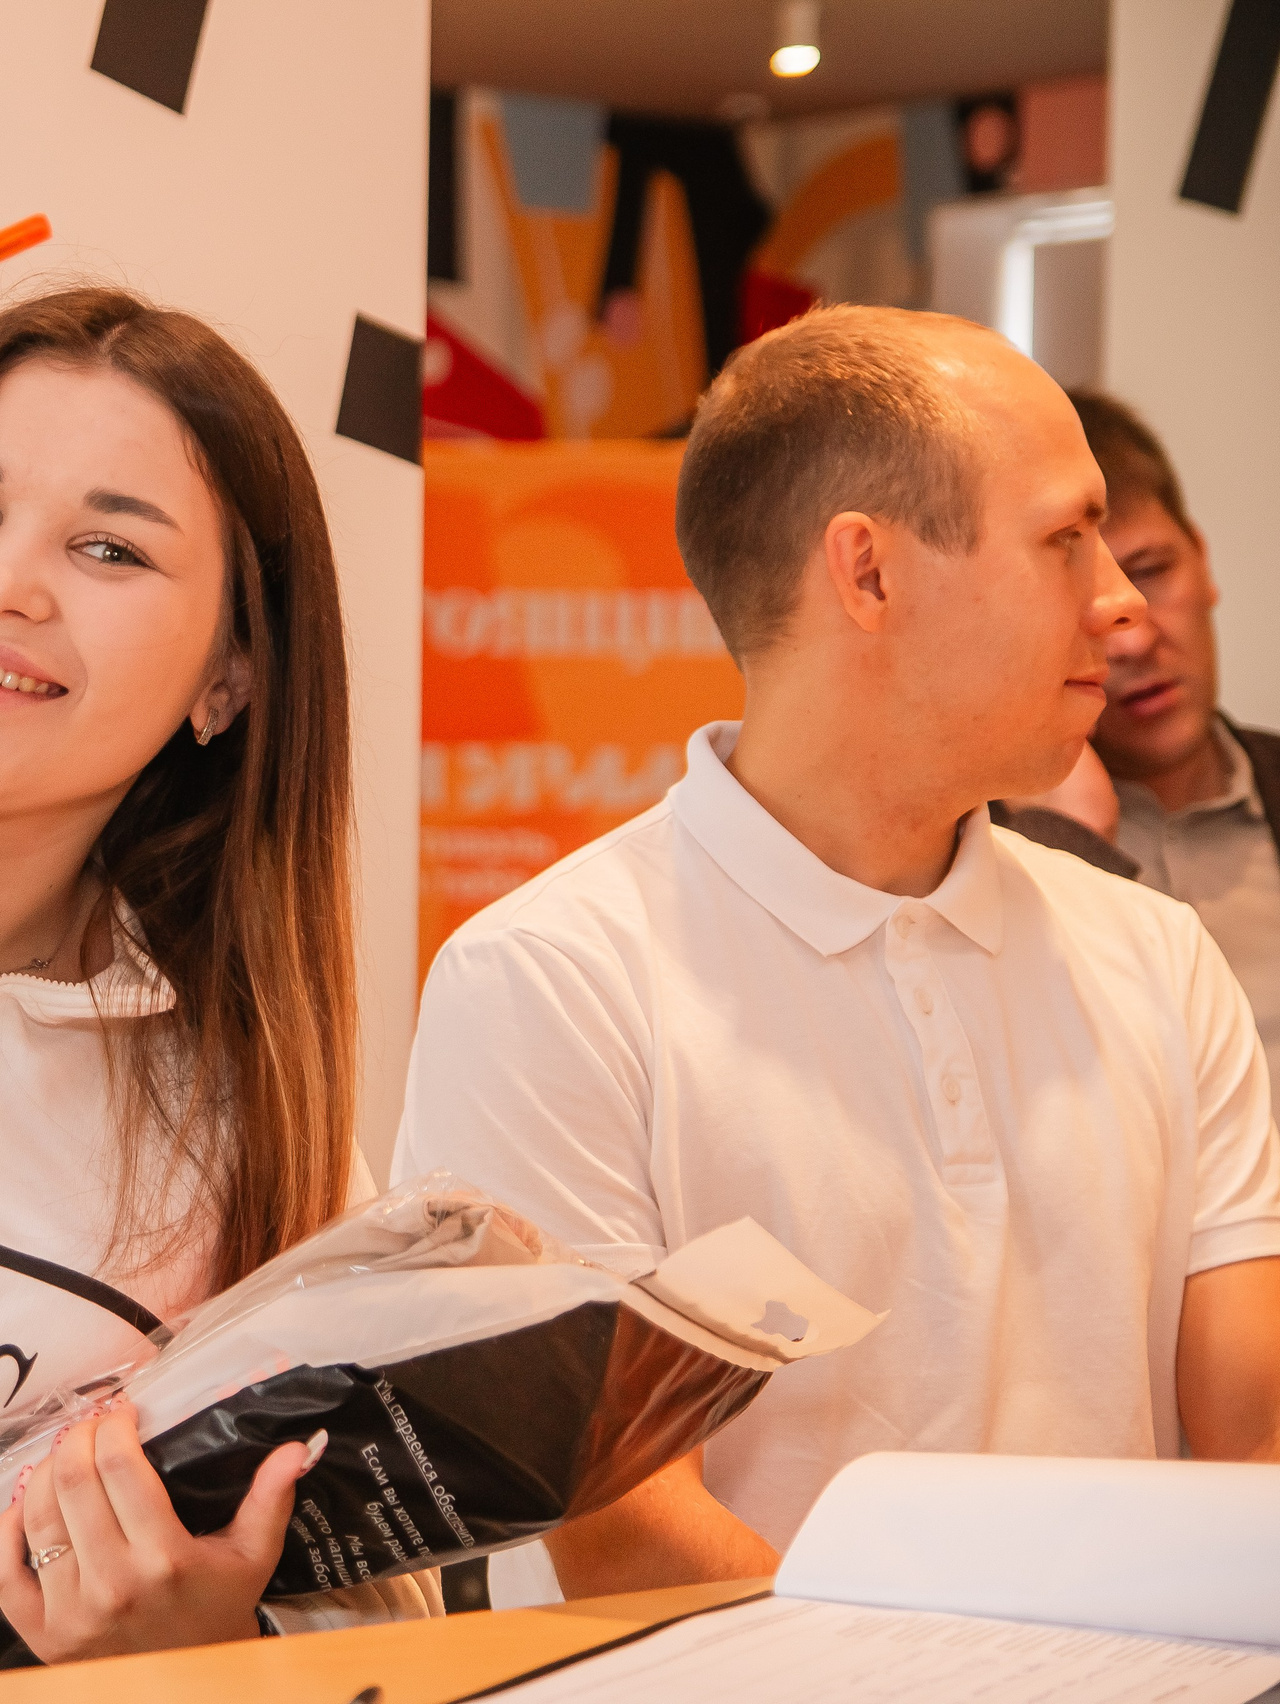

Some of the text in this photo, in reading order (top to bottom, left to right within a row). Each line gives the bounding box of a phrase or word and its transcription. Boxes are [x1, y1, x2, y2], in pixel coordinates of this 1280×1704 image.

[391, 1404, 438, 1482] стараемся
[361, 1442, 390, 1485] Если
[384, 1487, 401, 1506] вы
[393, 1506, 425, 1546] хотите
[302, 1499, 332, 1535] просто
[367, 1501, 395, 1540] будем
[345, 1533, 364, 1556] Мы
